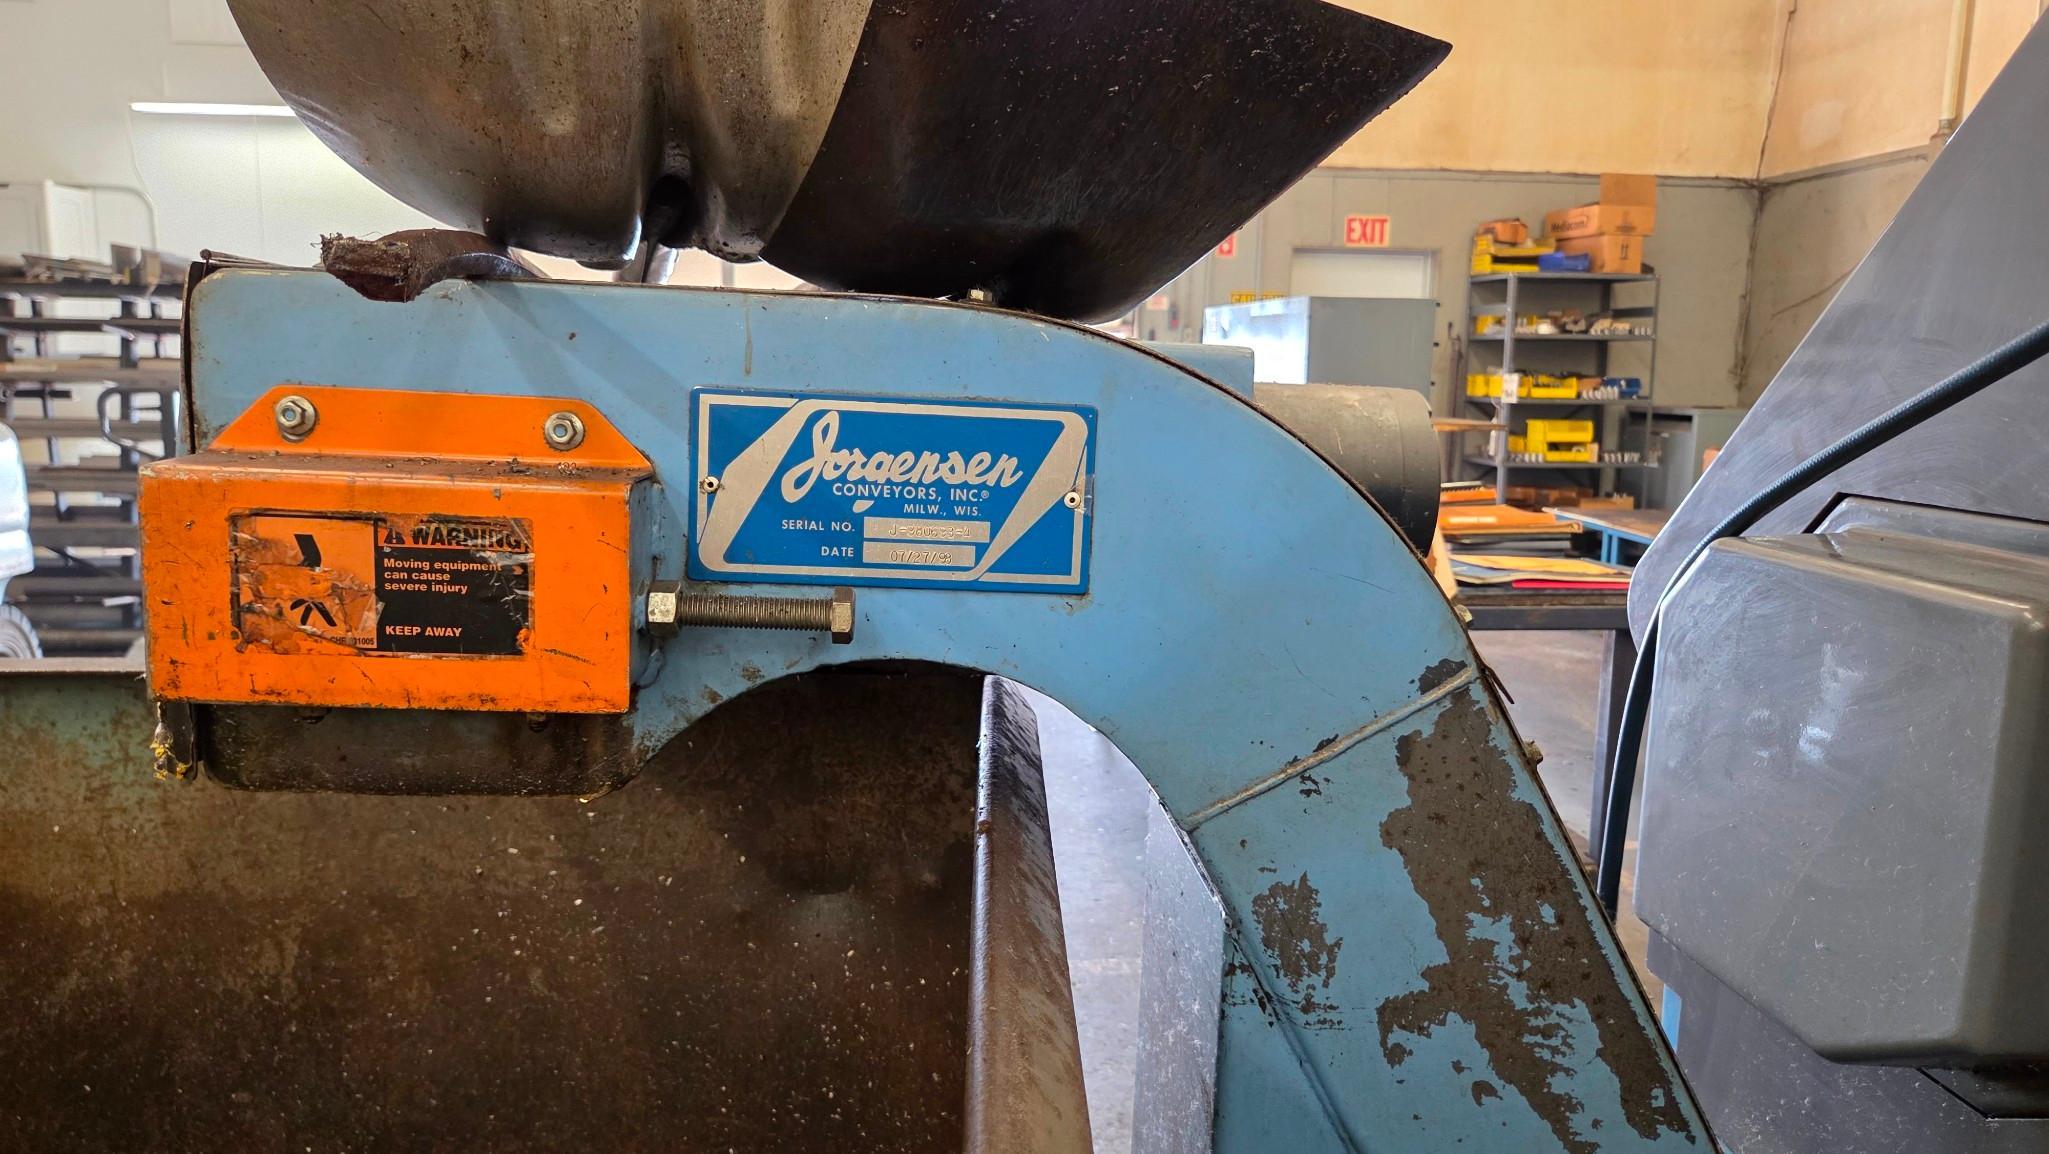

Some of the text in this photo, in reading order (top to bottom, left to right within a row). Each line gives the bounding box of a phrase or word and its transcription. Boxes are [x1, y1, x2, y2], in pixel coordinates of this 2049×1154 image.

[1346, 217, 1389, 245] EXIT
[781, 410, 1024, 513] Jorgensen
[832, 482, 942, 502] CONVEYORS,
[954, 505, 982, 517] WIS.
[781, 519, 825, 531] SERIAL
[831, 521, 856, 532] NO.
[821, 546, 953, 565] DATE 07/27/98
[383, 558, 503, 572] Moving equipment
[384, 571, 451, 580] can cause
[384, 582, 468, 594] severe injury
[385, 625, 462, 637] KEEP AWAY
